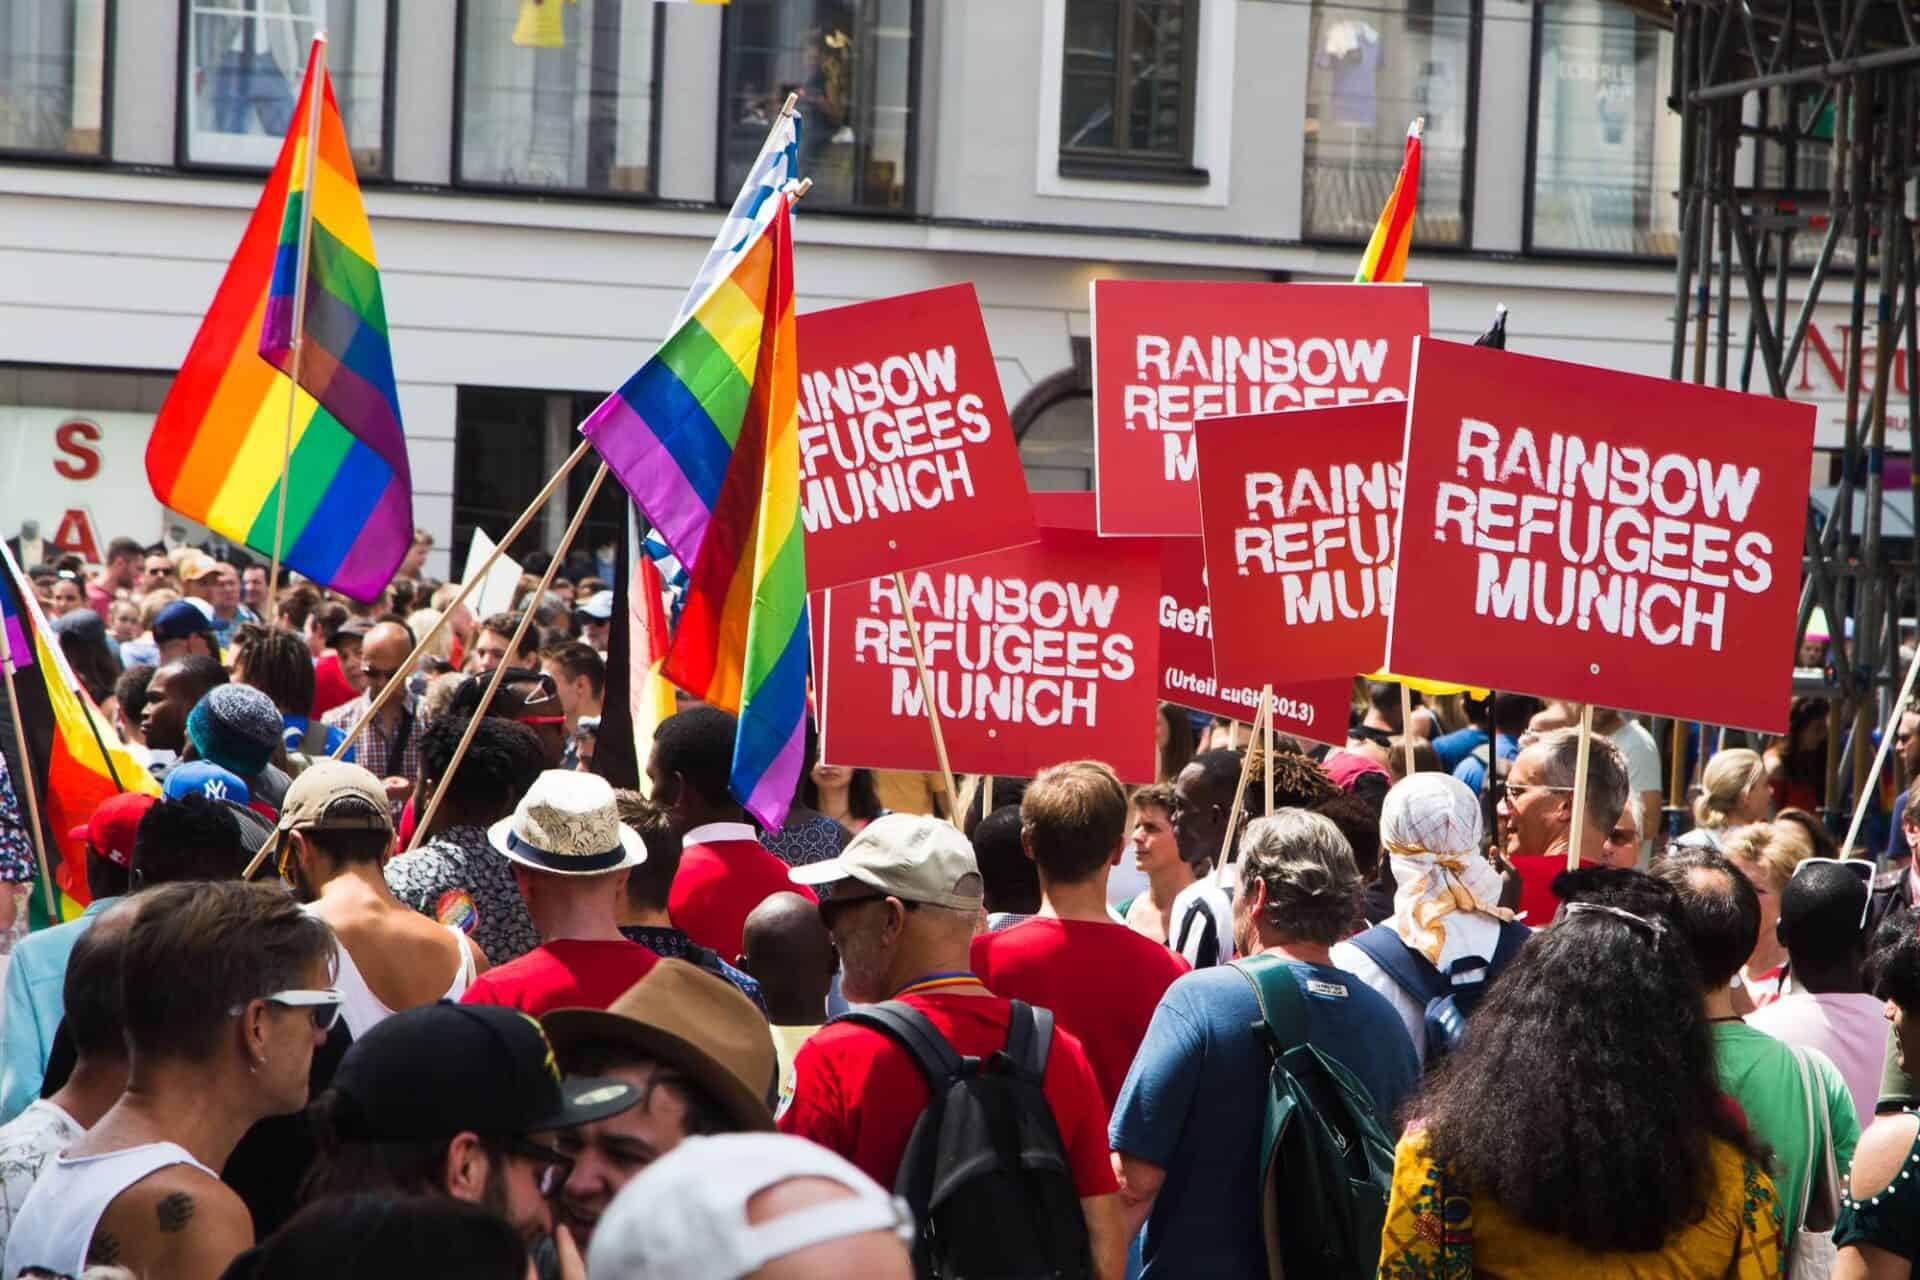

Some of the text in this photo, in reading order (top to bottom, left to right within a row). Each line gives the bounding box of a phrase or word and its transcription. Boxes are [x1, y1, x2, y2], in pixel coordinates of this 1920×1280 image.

[797, 345, 957, 423] INBOW
[1136, 334, 1388, 385] RAINBOW
[799, 393, 991, 480] FUGEES
[1124, 384, 1407, 431] REFUG
[1245, 462, 1404, 520] RAIN
[1456, 418, 1760, 522] RAINBOW
[1235, 514, 1400, 576] REFU
[1434, 481, 1773, 593] REFUGEES
[870, 572, 1119, 628] RAINBOW
[1475, 551, 1726, 651] MUNICH
[855, 617, 1135, 680] REFUGEES
[892, 667, 1097, 727] MUNICH
